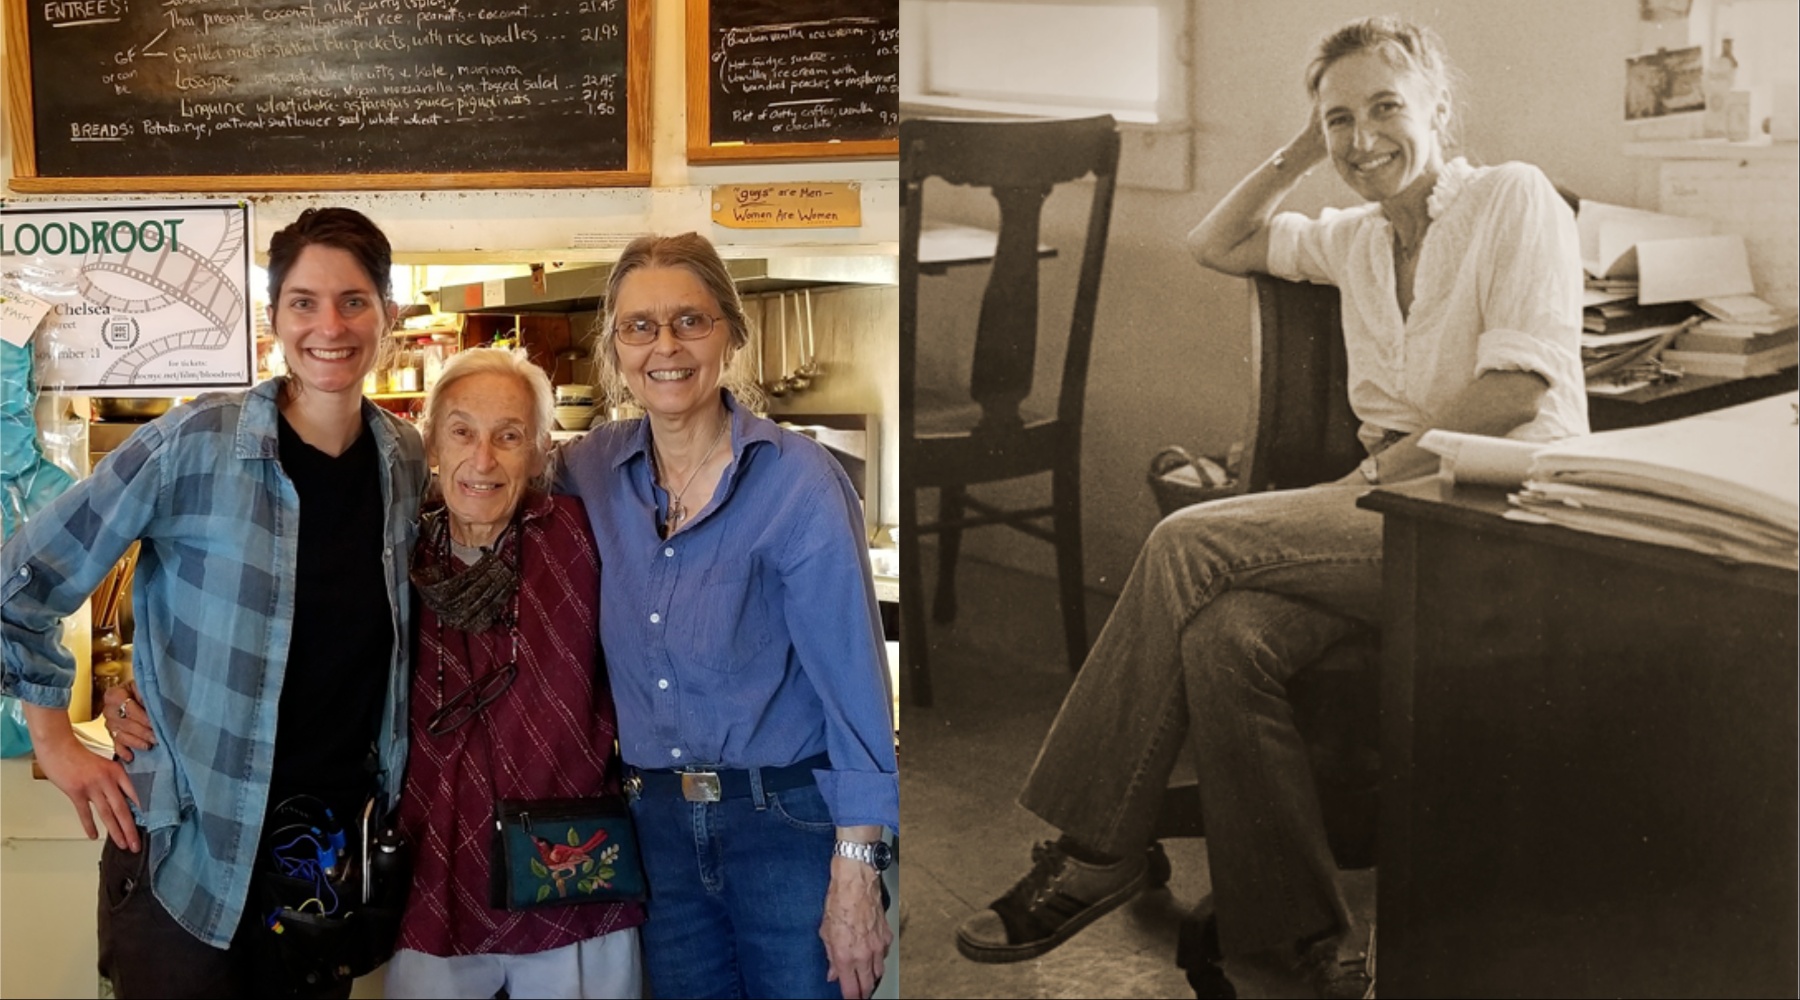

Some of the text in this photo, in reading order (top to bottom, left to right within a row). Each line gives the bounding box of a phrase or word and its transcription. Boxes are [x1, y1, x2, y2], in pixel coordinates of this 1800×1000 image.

[580, 25, 618, 42] 21.95
[71, 121, 134, 138] BREADS:
[778, 188, 797, 197] are
[799, 187, 822, 198] Men
[733, 208, 839, 223] Women Are Women
[54, 302, 111, 316] Chelsea
